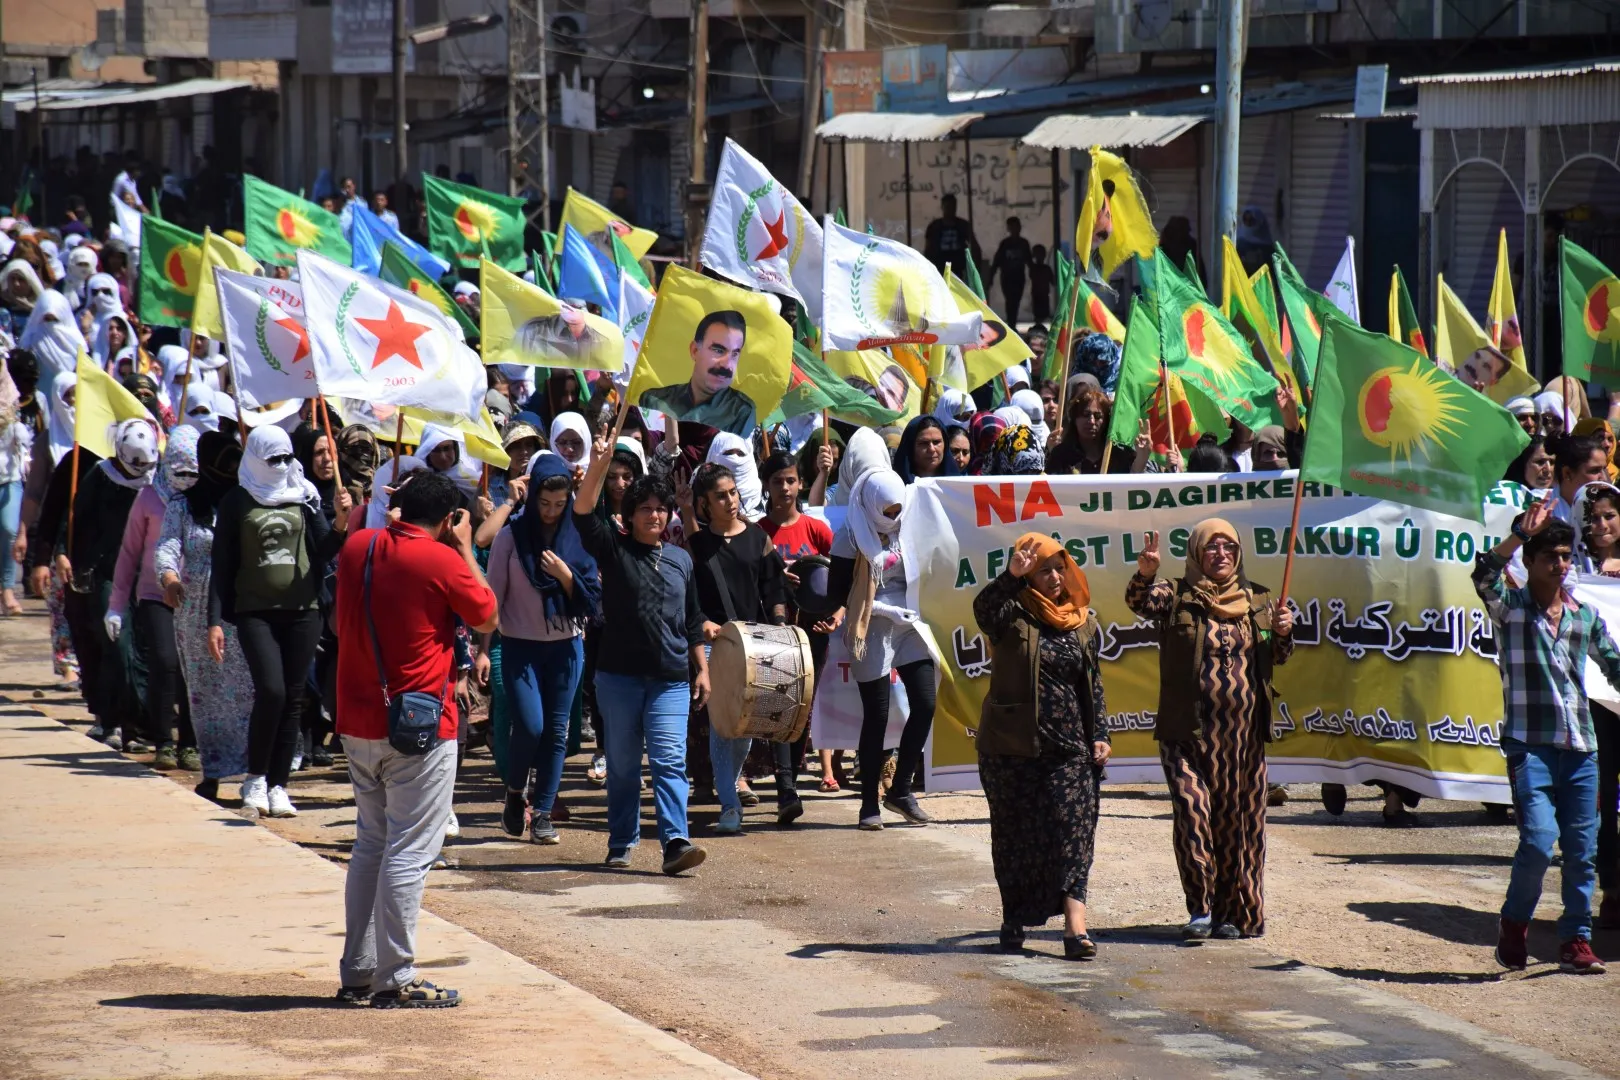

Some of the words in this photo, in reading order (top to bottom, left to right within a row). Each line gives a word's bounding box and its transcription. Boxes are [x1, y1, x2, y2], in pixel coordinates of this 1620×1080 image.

[267, 285, 302, 309] PYD
[384, 376, 416, 387] 2003
[973, 481, 1064, 527] NA
[1080, 492, 1113, 513] JI
[955, 558, 977, 588] A
[1396, 519, 1420, 558] Û
[1326, 598, 1465, 662] التركية
